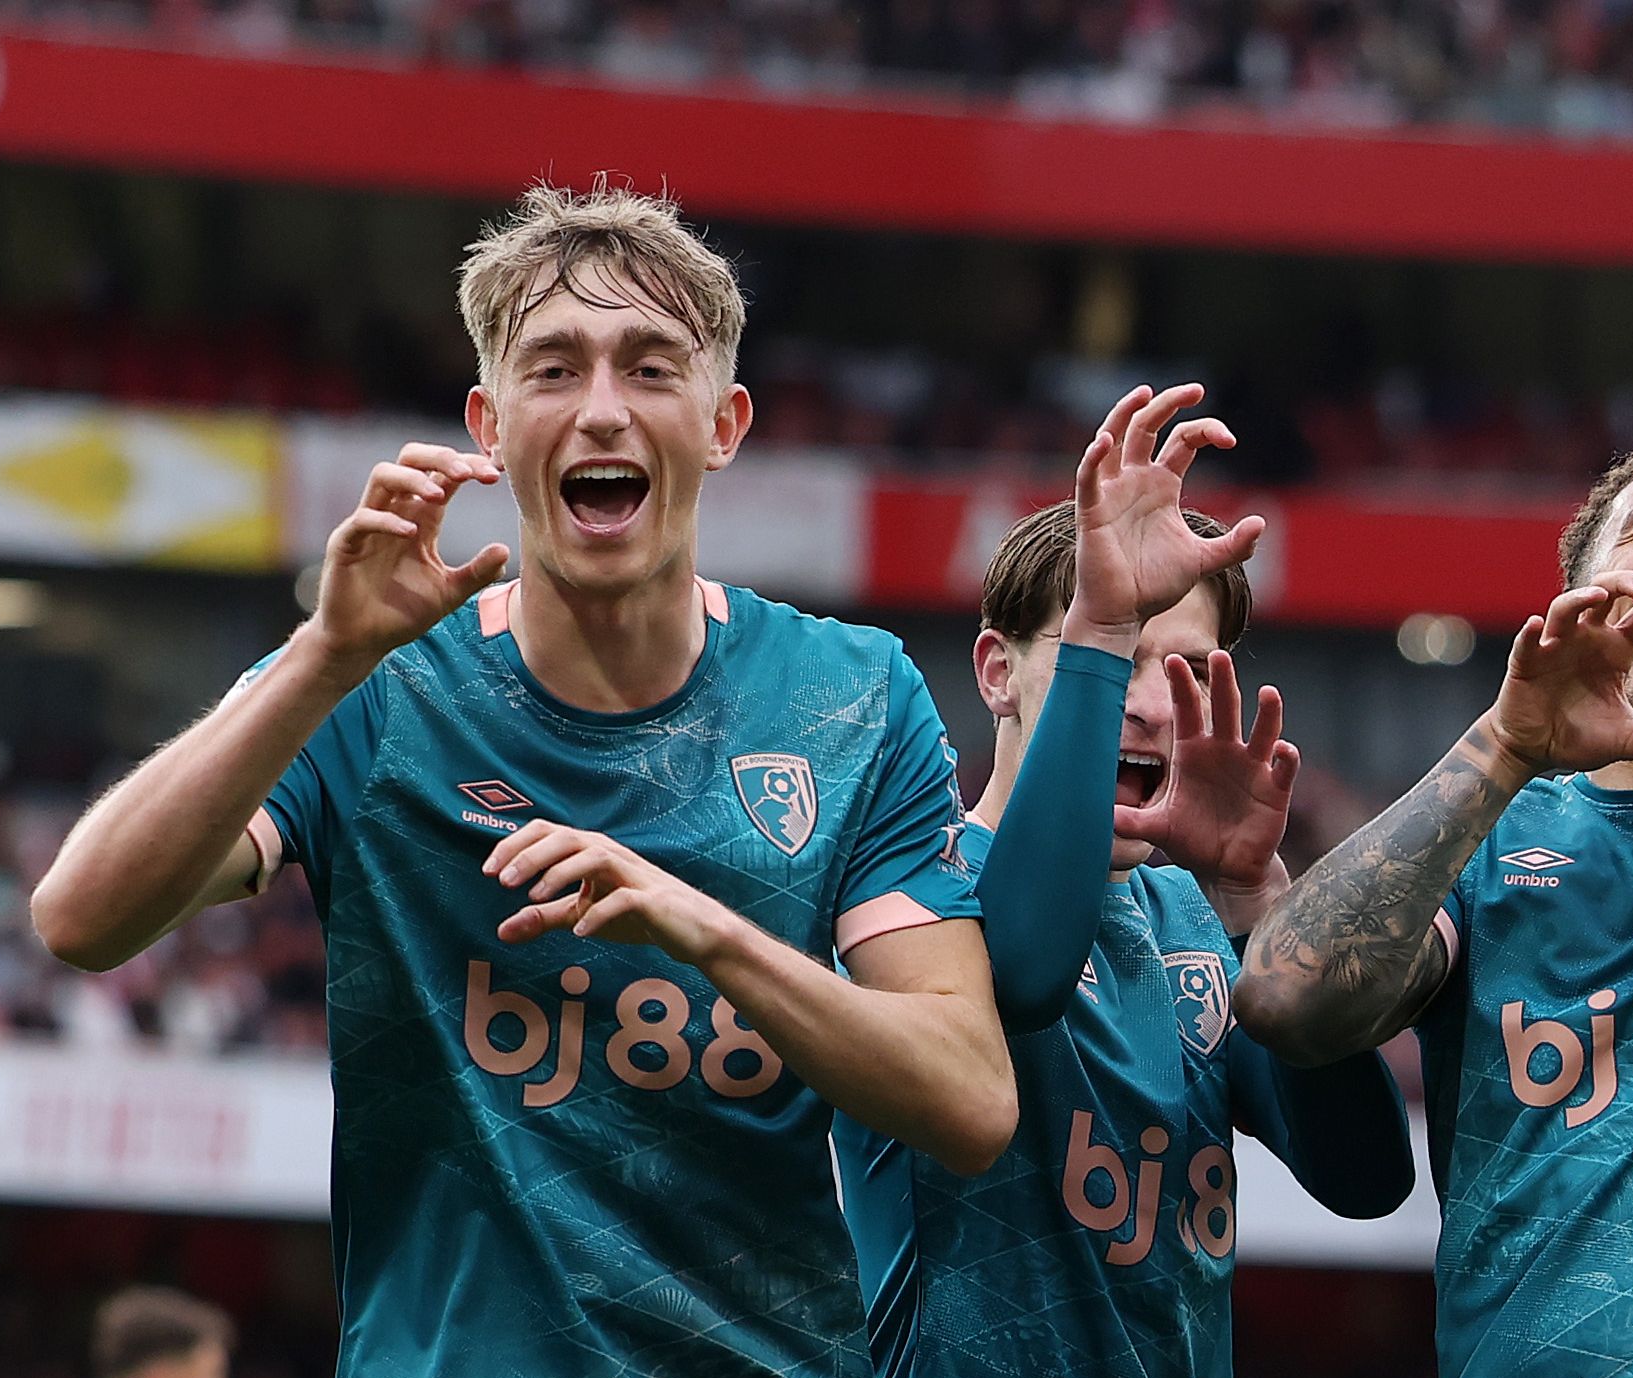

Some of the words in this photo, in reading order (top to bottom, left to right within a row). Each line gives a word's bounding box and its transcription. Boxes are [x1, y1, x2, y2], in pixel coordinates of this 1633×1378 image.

[462, 810, 518, 832] umbro
[1504, 872, 1560, 888] umbro
[464, 959, 783, 1108] bj88
